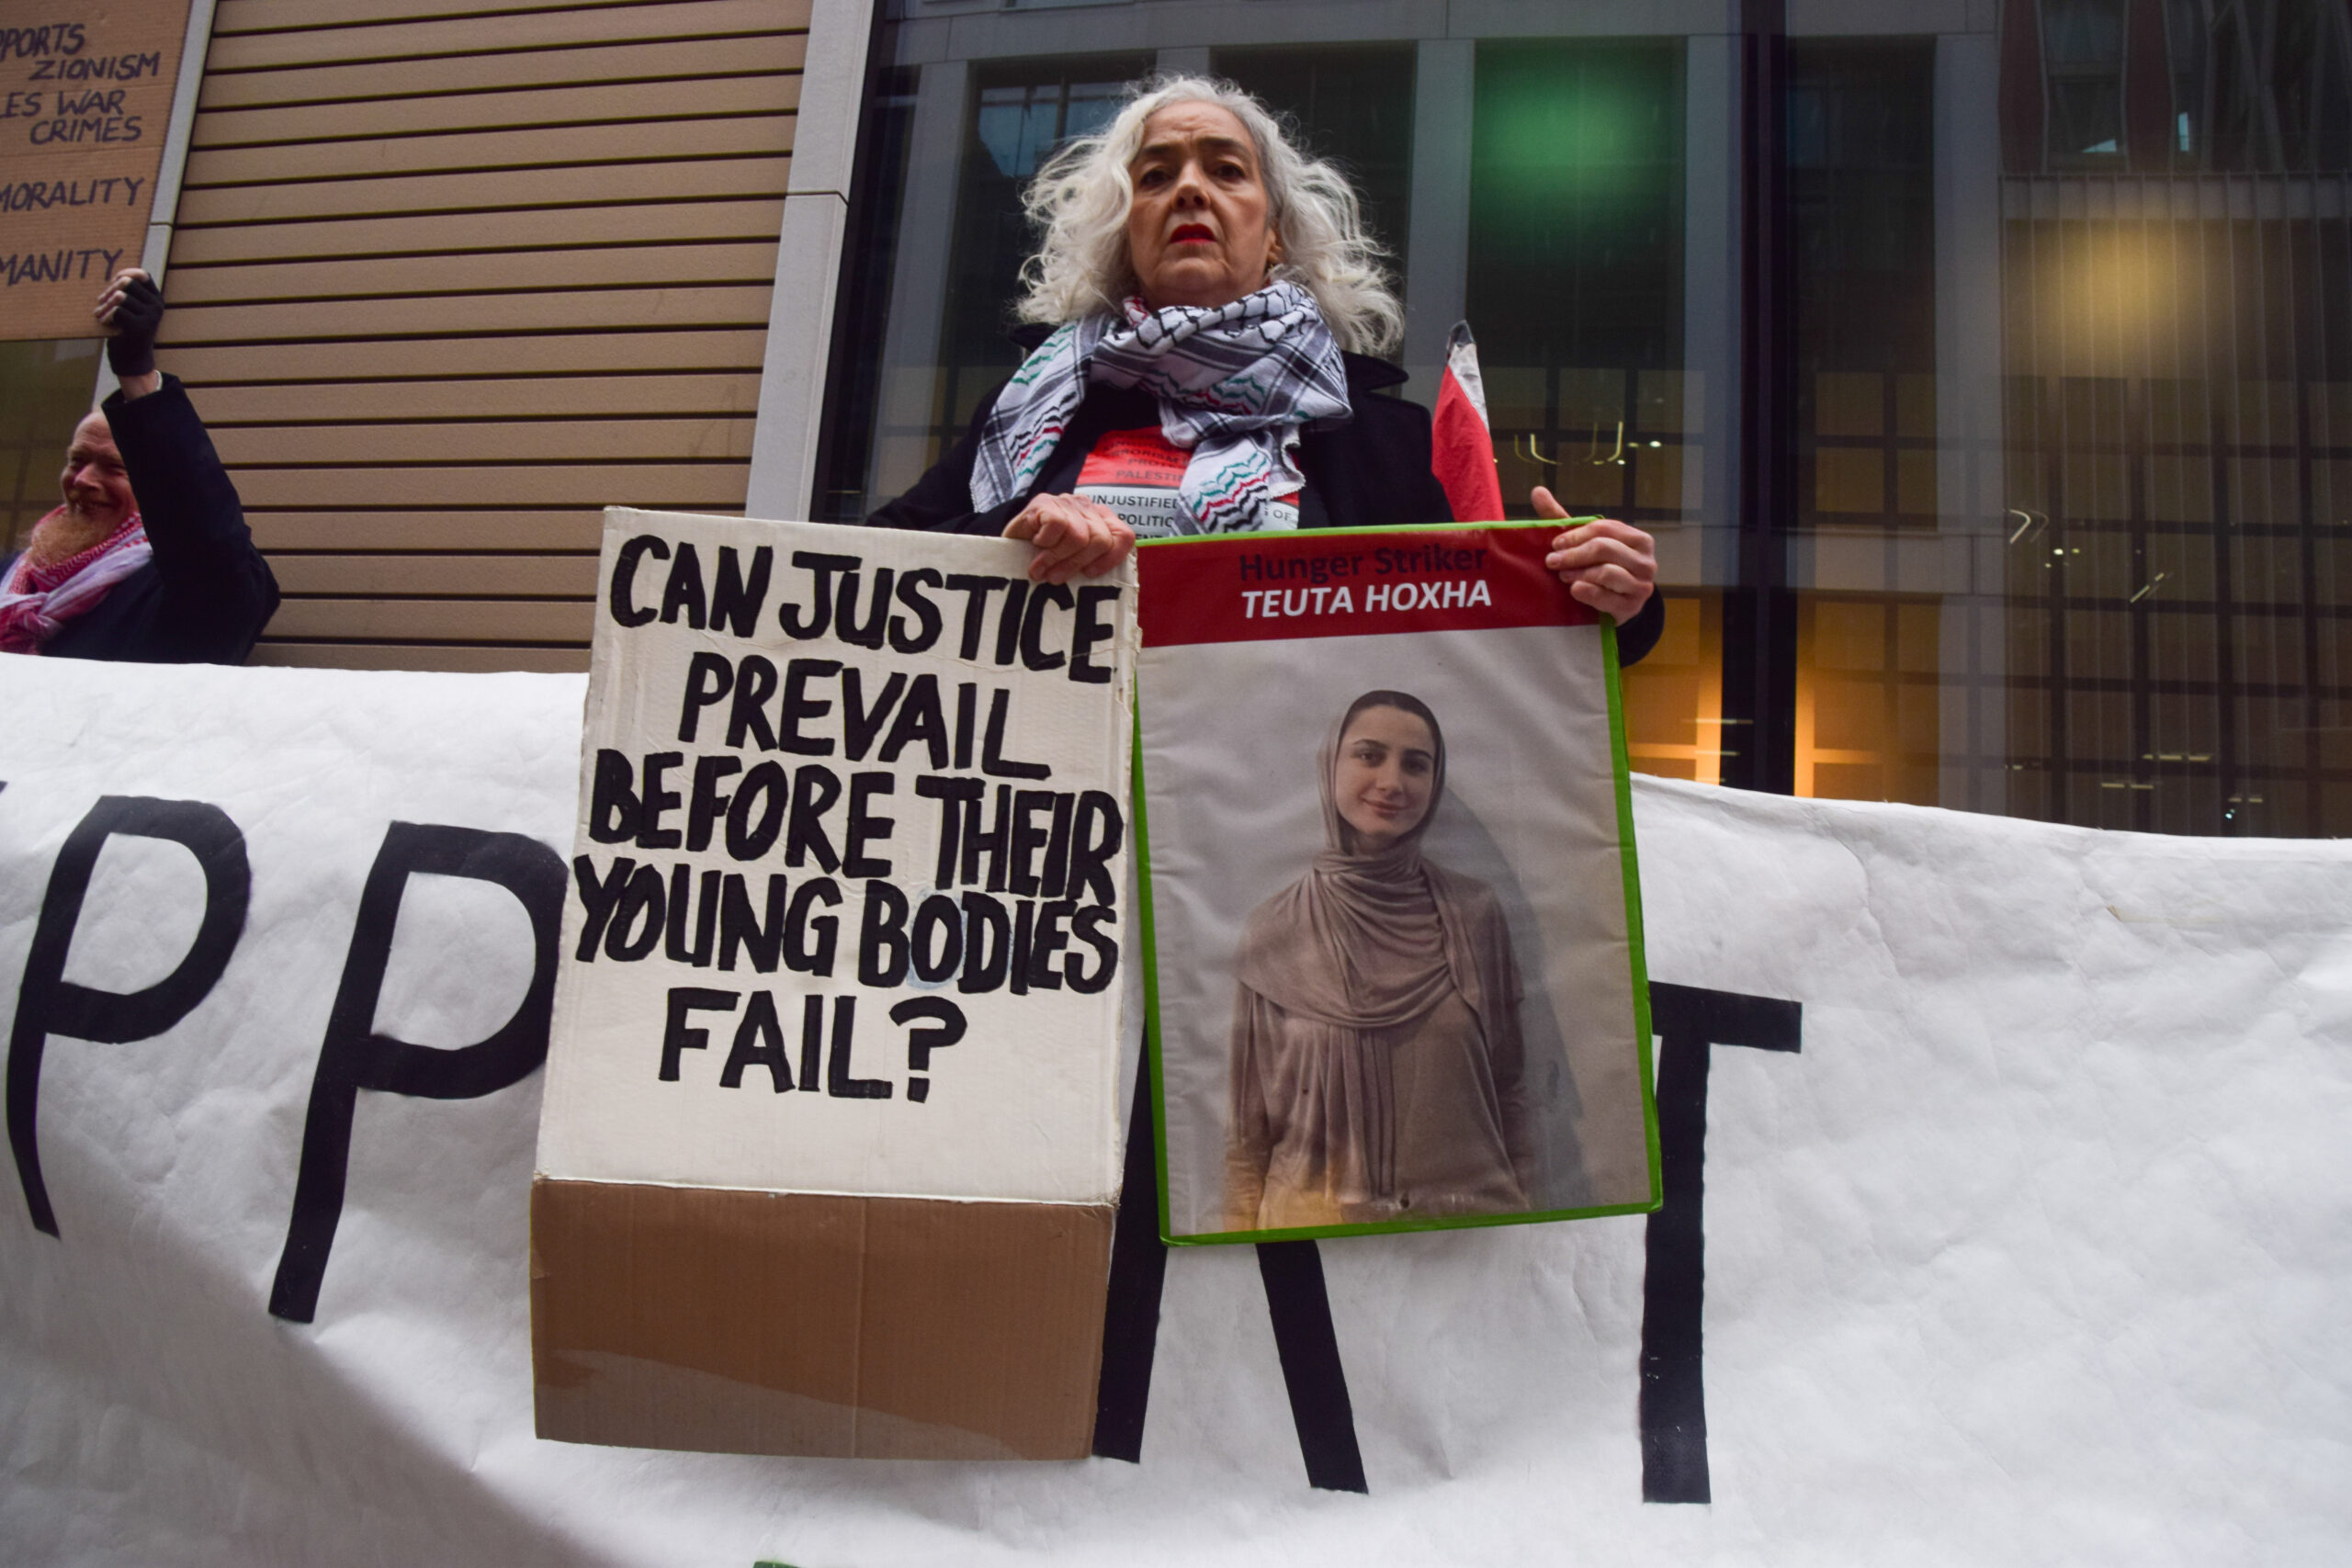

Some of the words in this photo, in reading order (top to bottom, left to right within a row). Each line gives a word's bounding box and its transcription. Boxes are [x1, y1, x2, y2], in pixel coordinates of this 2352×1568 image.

[0, 23, 85, 62] PORTS
[28, 51, 161, 81] ZIONISM
[0, 92, 41, 118] ES
[58, 89, 125, 116] WAR
[30, 116, 142, 145] CRIMES
[1239, 554, 1363, 584] Hunger
[1374, 543, 1487, 575] Striker
[609, 535, 773, 638] CAN
[778, 550, 1121, 683] JUSTICE
[1242, 586, 1354, 619] TEUTA
[1365, 580, 1492, 613] HOXHA
[678, 650, 1051, 781] PREVAIL
[588, 749, 895, 879] BEFORE
[915, 774, 1124, 907] THEIR
[572, 853, 843, 977] YOUNG
[857, 879, 1119, 996] BODIES
[658, 987, 967, 1103] FAIL?
